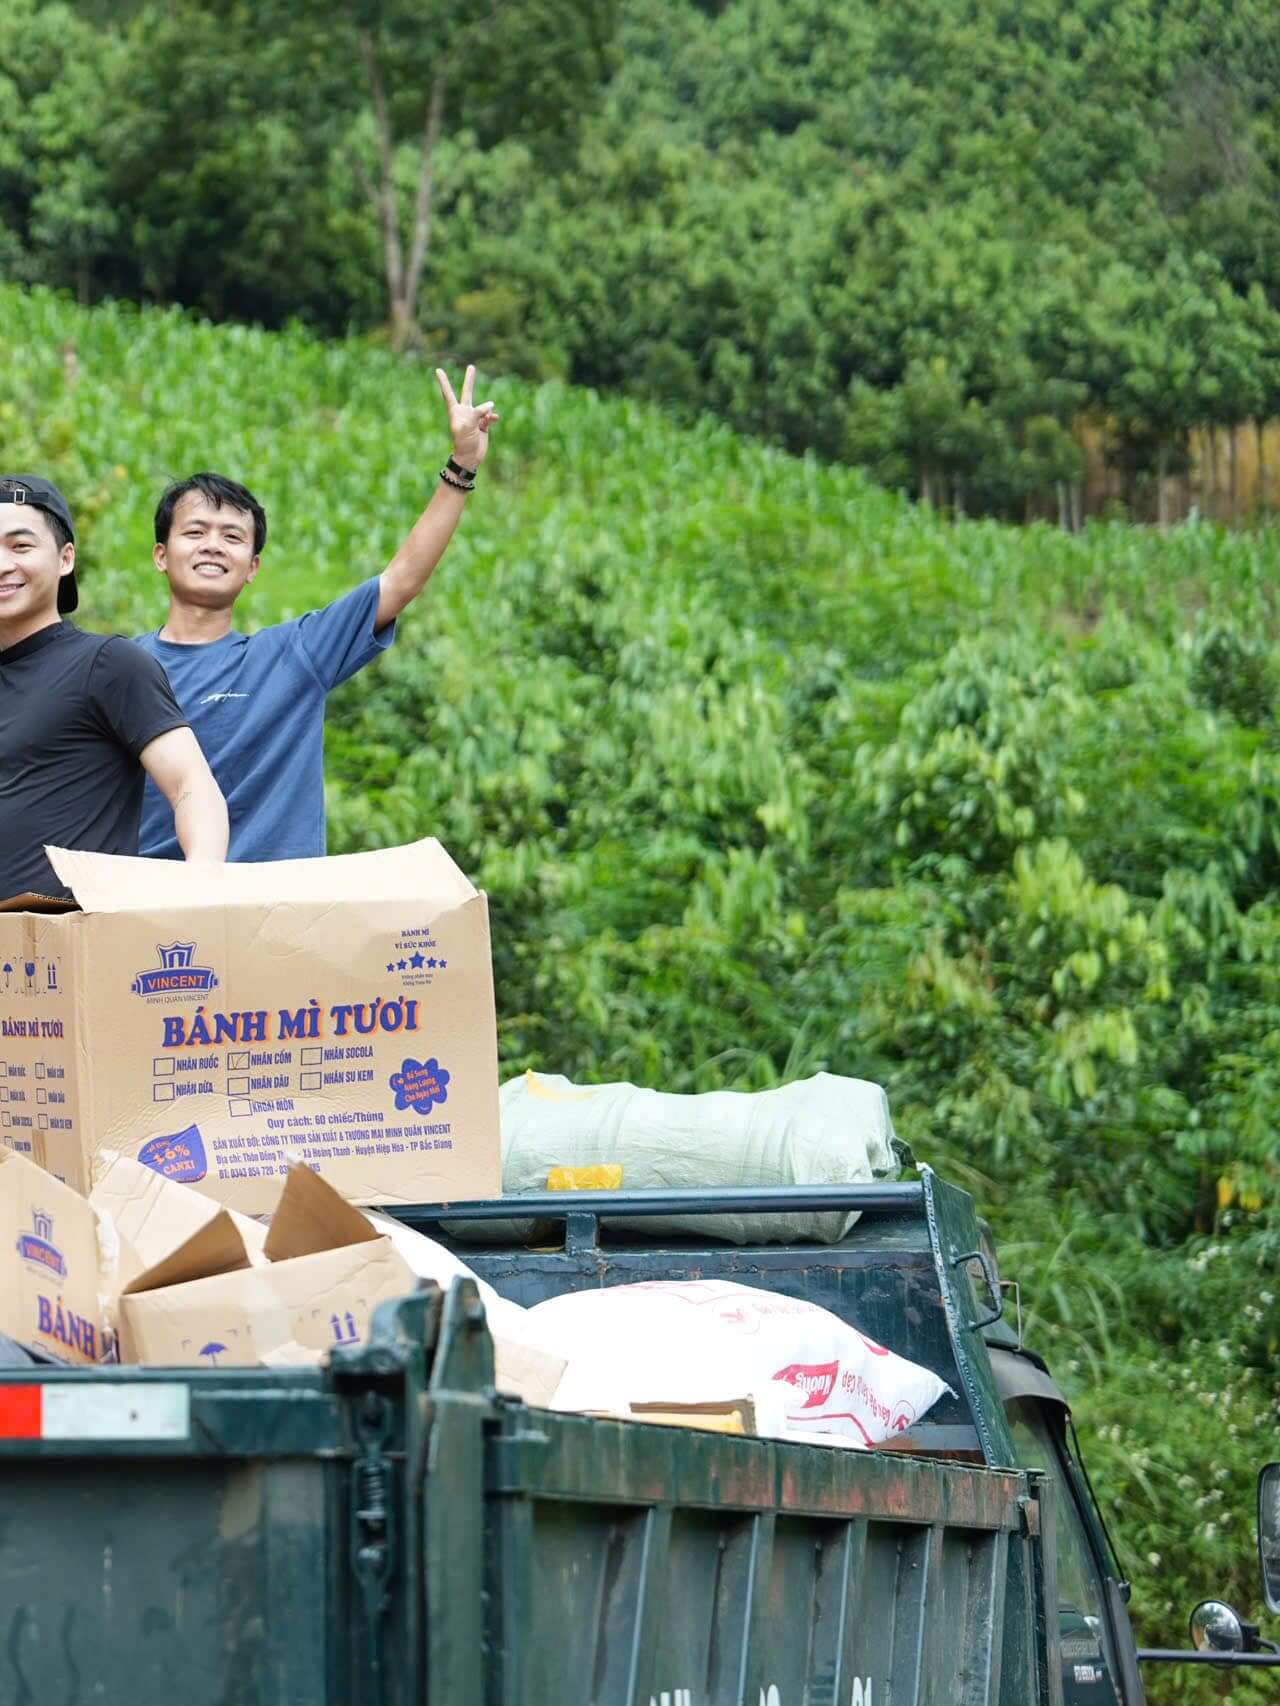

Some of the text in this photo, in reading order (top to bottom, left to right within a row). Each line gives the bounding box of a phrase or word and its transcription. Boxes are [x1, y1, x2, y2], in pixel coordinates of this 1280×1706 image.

[148, 975, 205, 990] VINCENT
[2, 1016, 64, 1038] BÁNH MÌ TƯƠI
[162, 995, 419, 1048] BÁNH MÌ TƯƠI
[251, 1052, 273, 1066] NHÂN
[324, 1046, 374, 1061] NHÂN SOCOLA
[176, 1056, 198, 1072] NHÂN
[250, 1074, 272, 1090] NHÂN
[324, 1070, 344, 1085] NHÂN
[357, 1070, 374, 1082] KEM
[176, 1081, 197, 1097] NHÂN
[267, 1118, 284, 1129] Quy
[315, 1114, 326, 1125] 60
[423, 1124, 451, 1135] VINCENT
[410, 1141, 418, 1152] TP
[163, 1160, 196, 1175] CANXI
[37, 1294, 96, 1361] BÁNH
